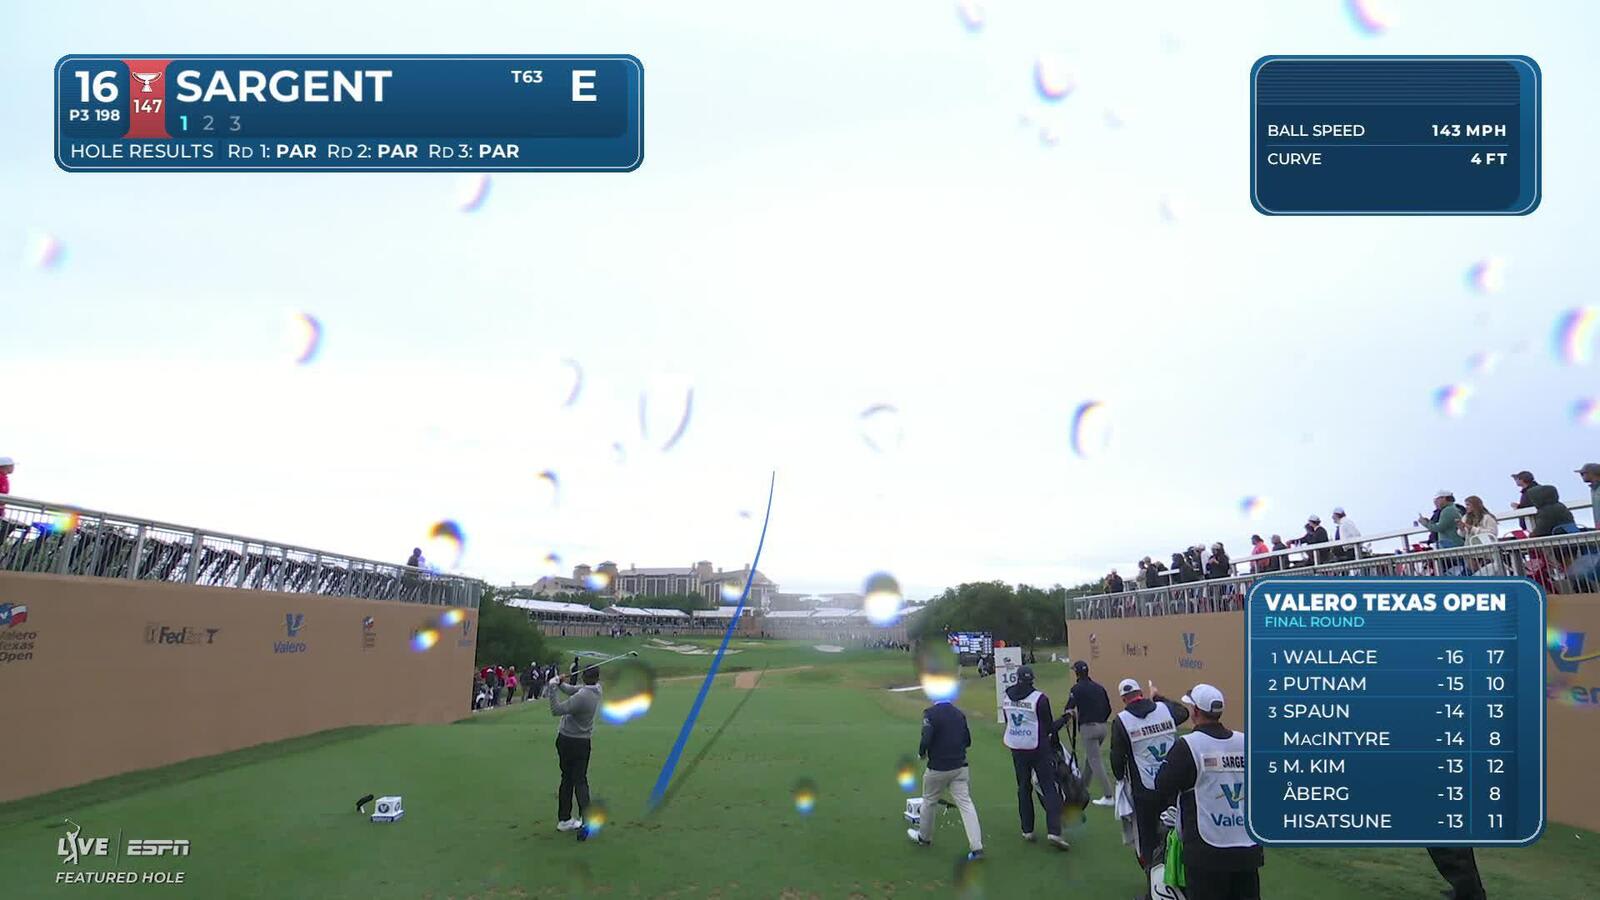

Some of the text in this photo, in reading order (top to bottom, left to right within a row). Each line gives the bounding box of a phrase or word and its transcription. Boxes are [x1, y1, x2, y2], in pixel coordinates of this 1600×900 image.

[273, 641, 306, 654] Valero
[1001, 672, 1017, 684] 16
[1140, 720, 1174, 737] STREELMAN
